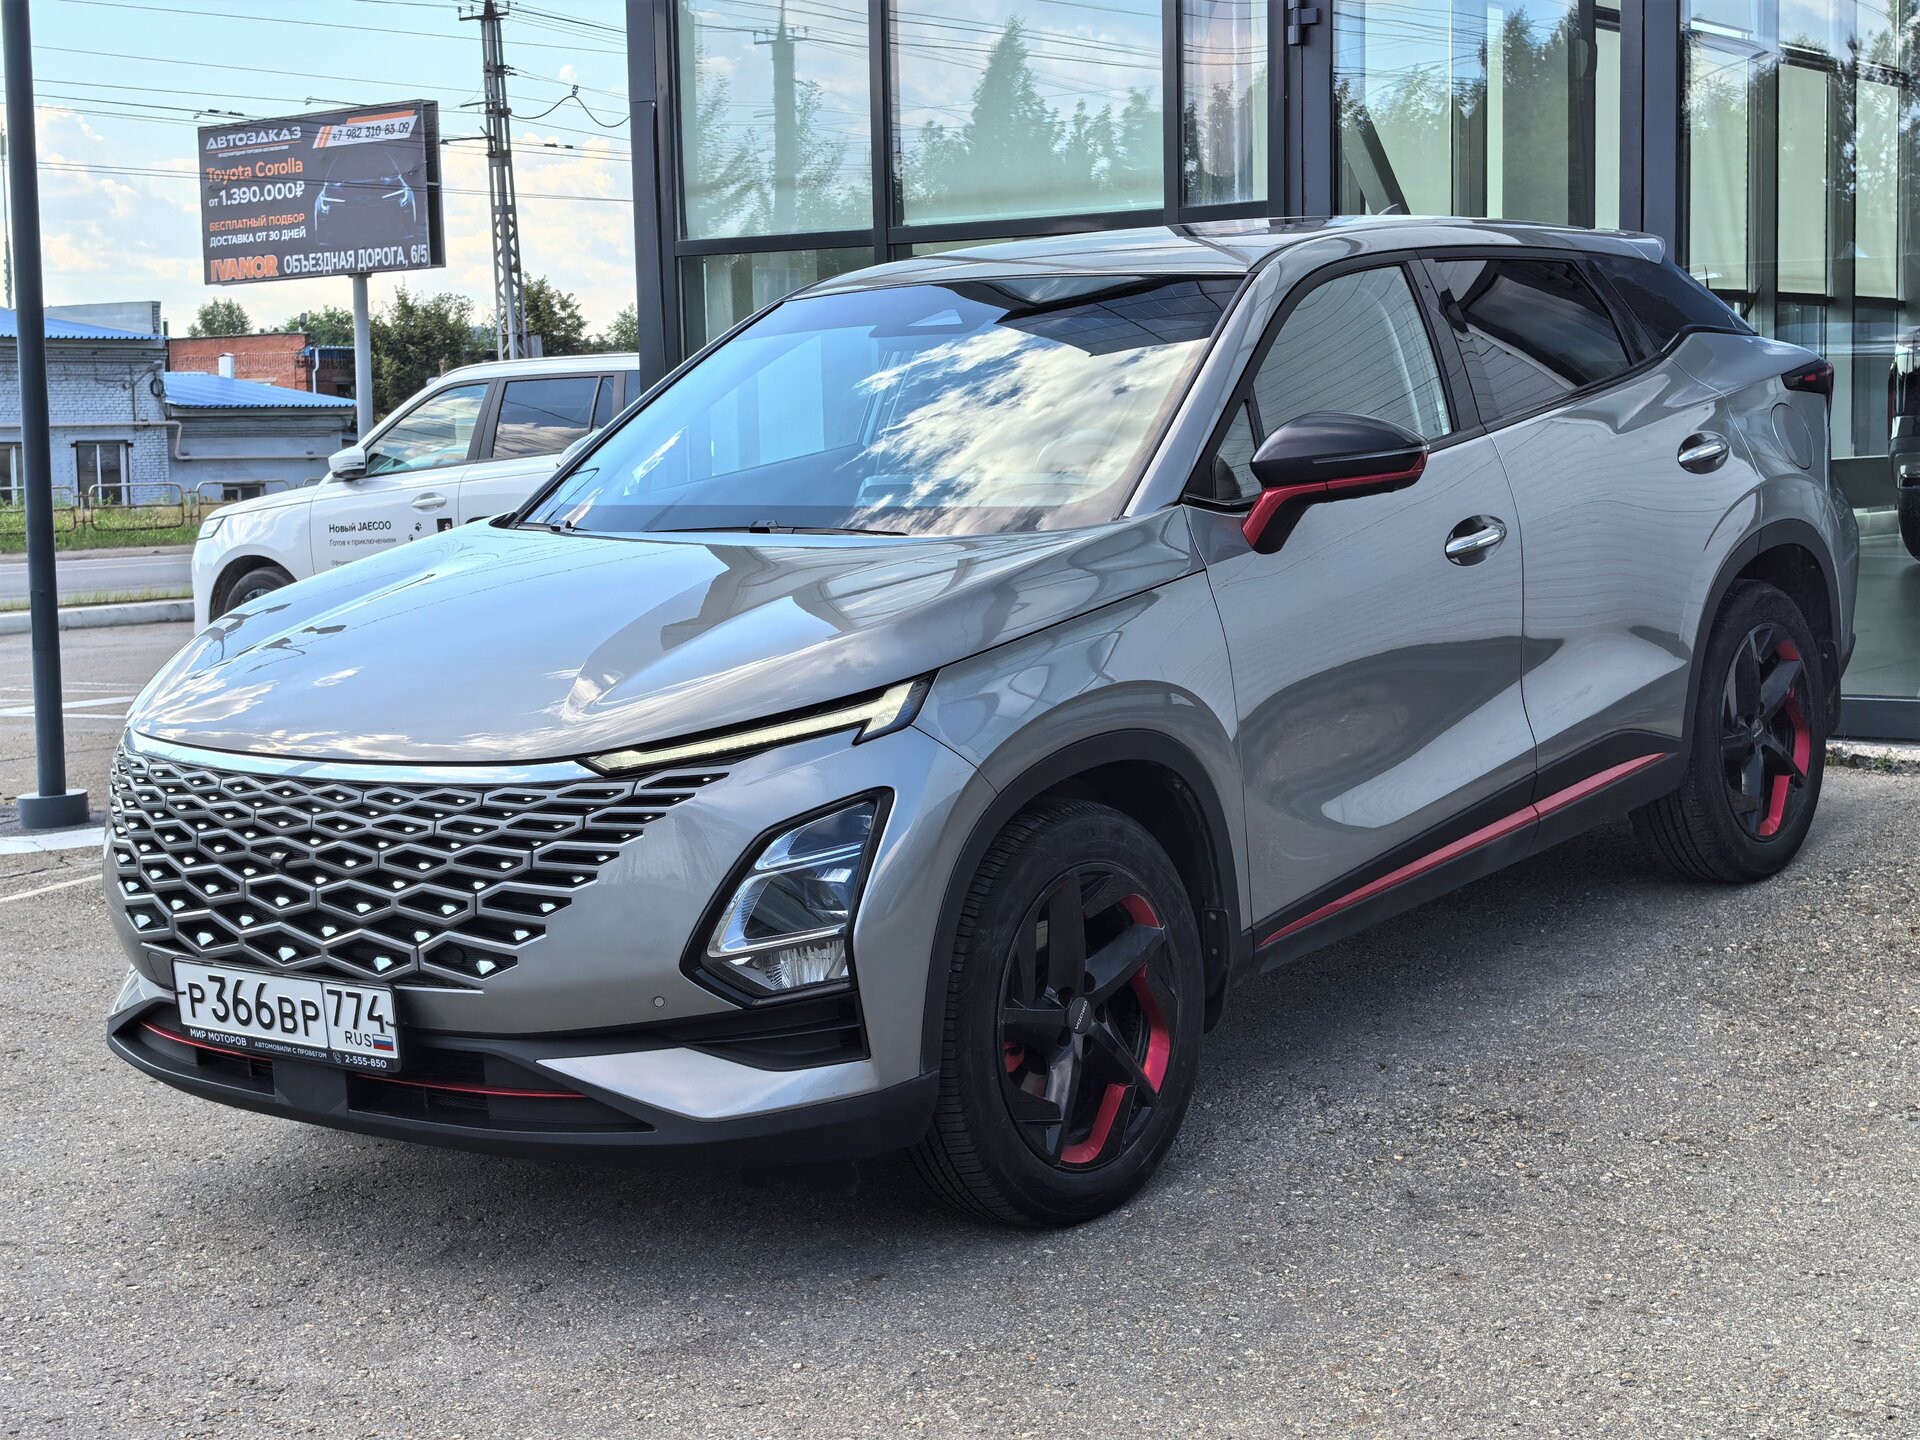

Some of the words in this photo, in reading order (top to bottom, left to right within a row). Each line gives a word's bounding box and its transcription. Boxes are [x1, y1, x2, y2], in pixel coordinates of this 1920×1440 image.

[206, 126, 302, 150] АВТОЗАКАЗ
[346, 127, 361, 139] 982
[365, 125, 381, 137] 310
[384, 123, 395, 135] 83
[398, 122, 409, 133] 09
[207, 165, 252, 185] Toyota
[256, 157, 303, 177] Corolla
[209, 198, 219, 207] от
[209, 214, 267, 232] БЕСПЛАТНЫЙ
[269, 213, 305, 226] ПОДБОР
[210, 234, 255, 248] ДОСТАВКА
[256, 231, 268, 242] ОТ
[269, 231, 280, 241] 30
[281, 226, 307, 241] ДНЕЙ
[211, 254, 279, 282] IVANOR
[284, 250, 355, 274] ОБЪЕЗДНАЯ
[357, 246, 409, 271] ДОРОГА,
[411, 244, 428, 264] 6/5
[329, 522, 356, 533] Новый
[358, 520, 392, 532] JAECOO
[329, 539, 346, 547] Готов
[351, 538, 396, 546] приключениям
[326, 988, 385, 1034] 774
[190, 1028, 207, 1039] МИР
[208, 1031, 247, 1046] МОТОРОВ
[345, 1030, 373, 1048] RUS
[254, 1041, 292, 1053] АВТОМОБИЛИ
[297, 1048, 327, 1059] ПРОБЕГОМ
[345, 1054, 387, 1069] 2-555-850
